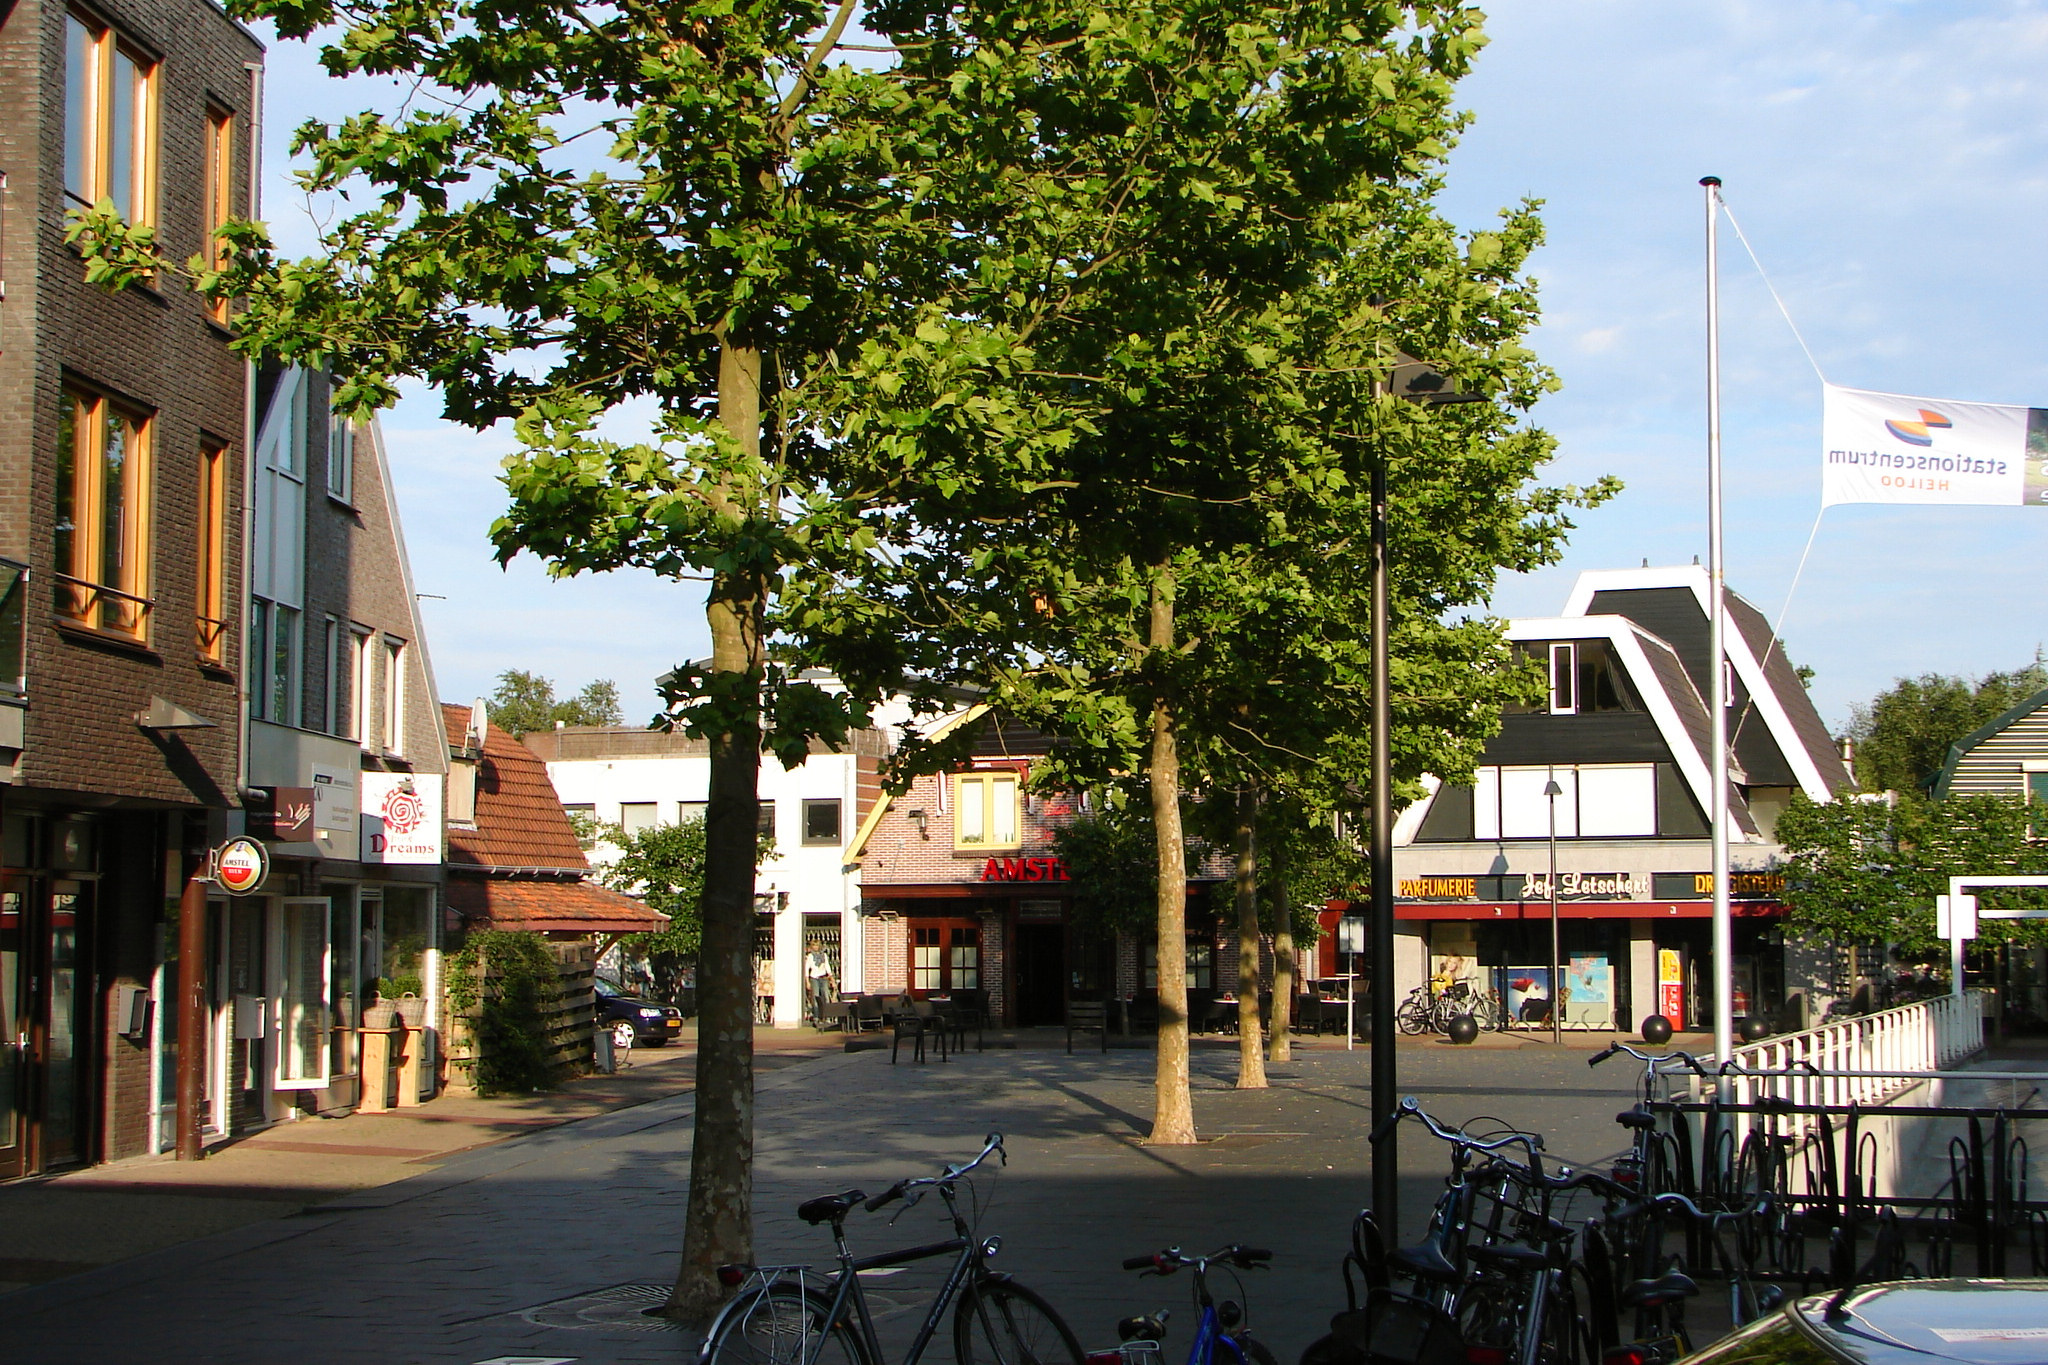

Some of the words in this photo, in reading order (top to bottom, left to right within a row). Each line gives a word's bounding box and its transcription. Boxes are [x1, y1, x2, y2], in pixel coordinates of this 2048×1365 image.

[370, 833, 435, 855] Dreams
[224, 859, 249, 867] AMSTEL
[1399, 878, 1476, 897] PARFUMERIE
[1521, 872, 1555, 900] Jef
[1556, 872, 1649, 895] Letschert
[1695, 874, 1786, 893] DRGISTERIJ
